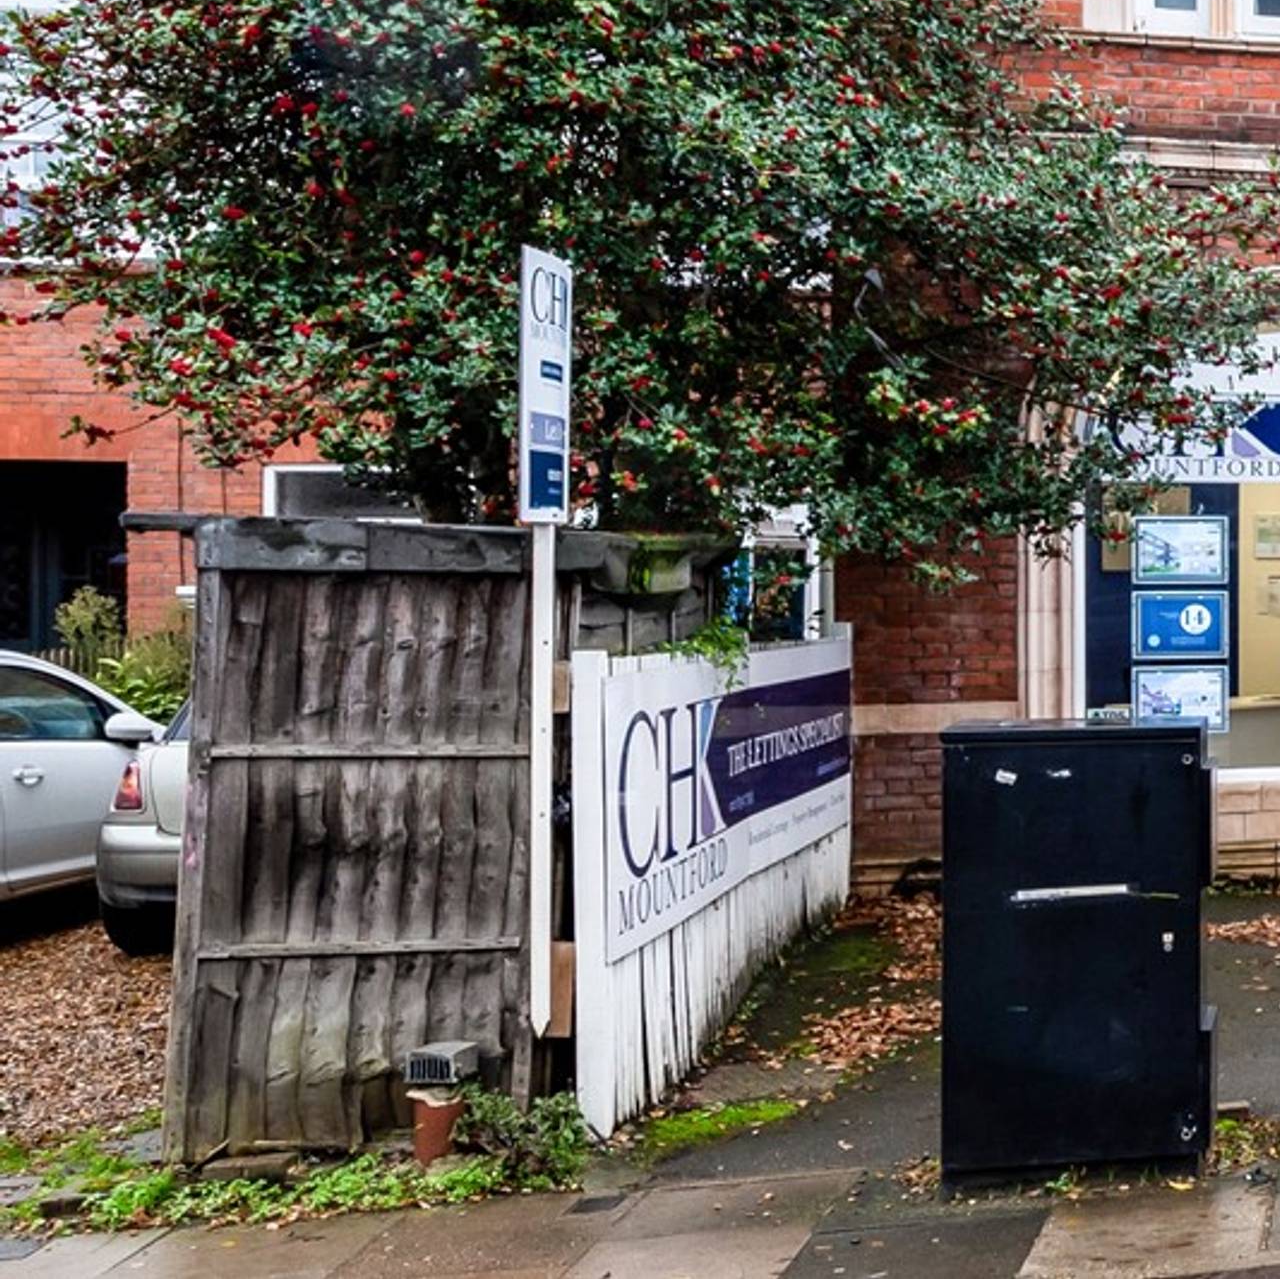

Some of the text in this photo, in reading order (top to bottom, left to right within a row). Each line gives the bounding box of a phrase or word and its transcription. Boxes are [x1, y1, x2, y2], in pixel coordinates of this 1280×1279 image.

[727, 741, 747, 777] THE
[747, 725, 799, 769] LETTINGS
[798, 712, 844, 754] SPECIALIST
[618, 837, 729, 935] MOUNTFORD
